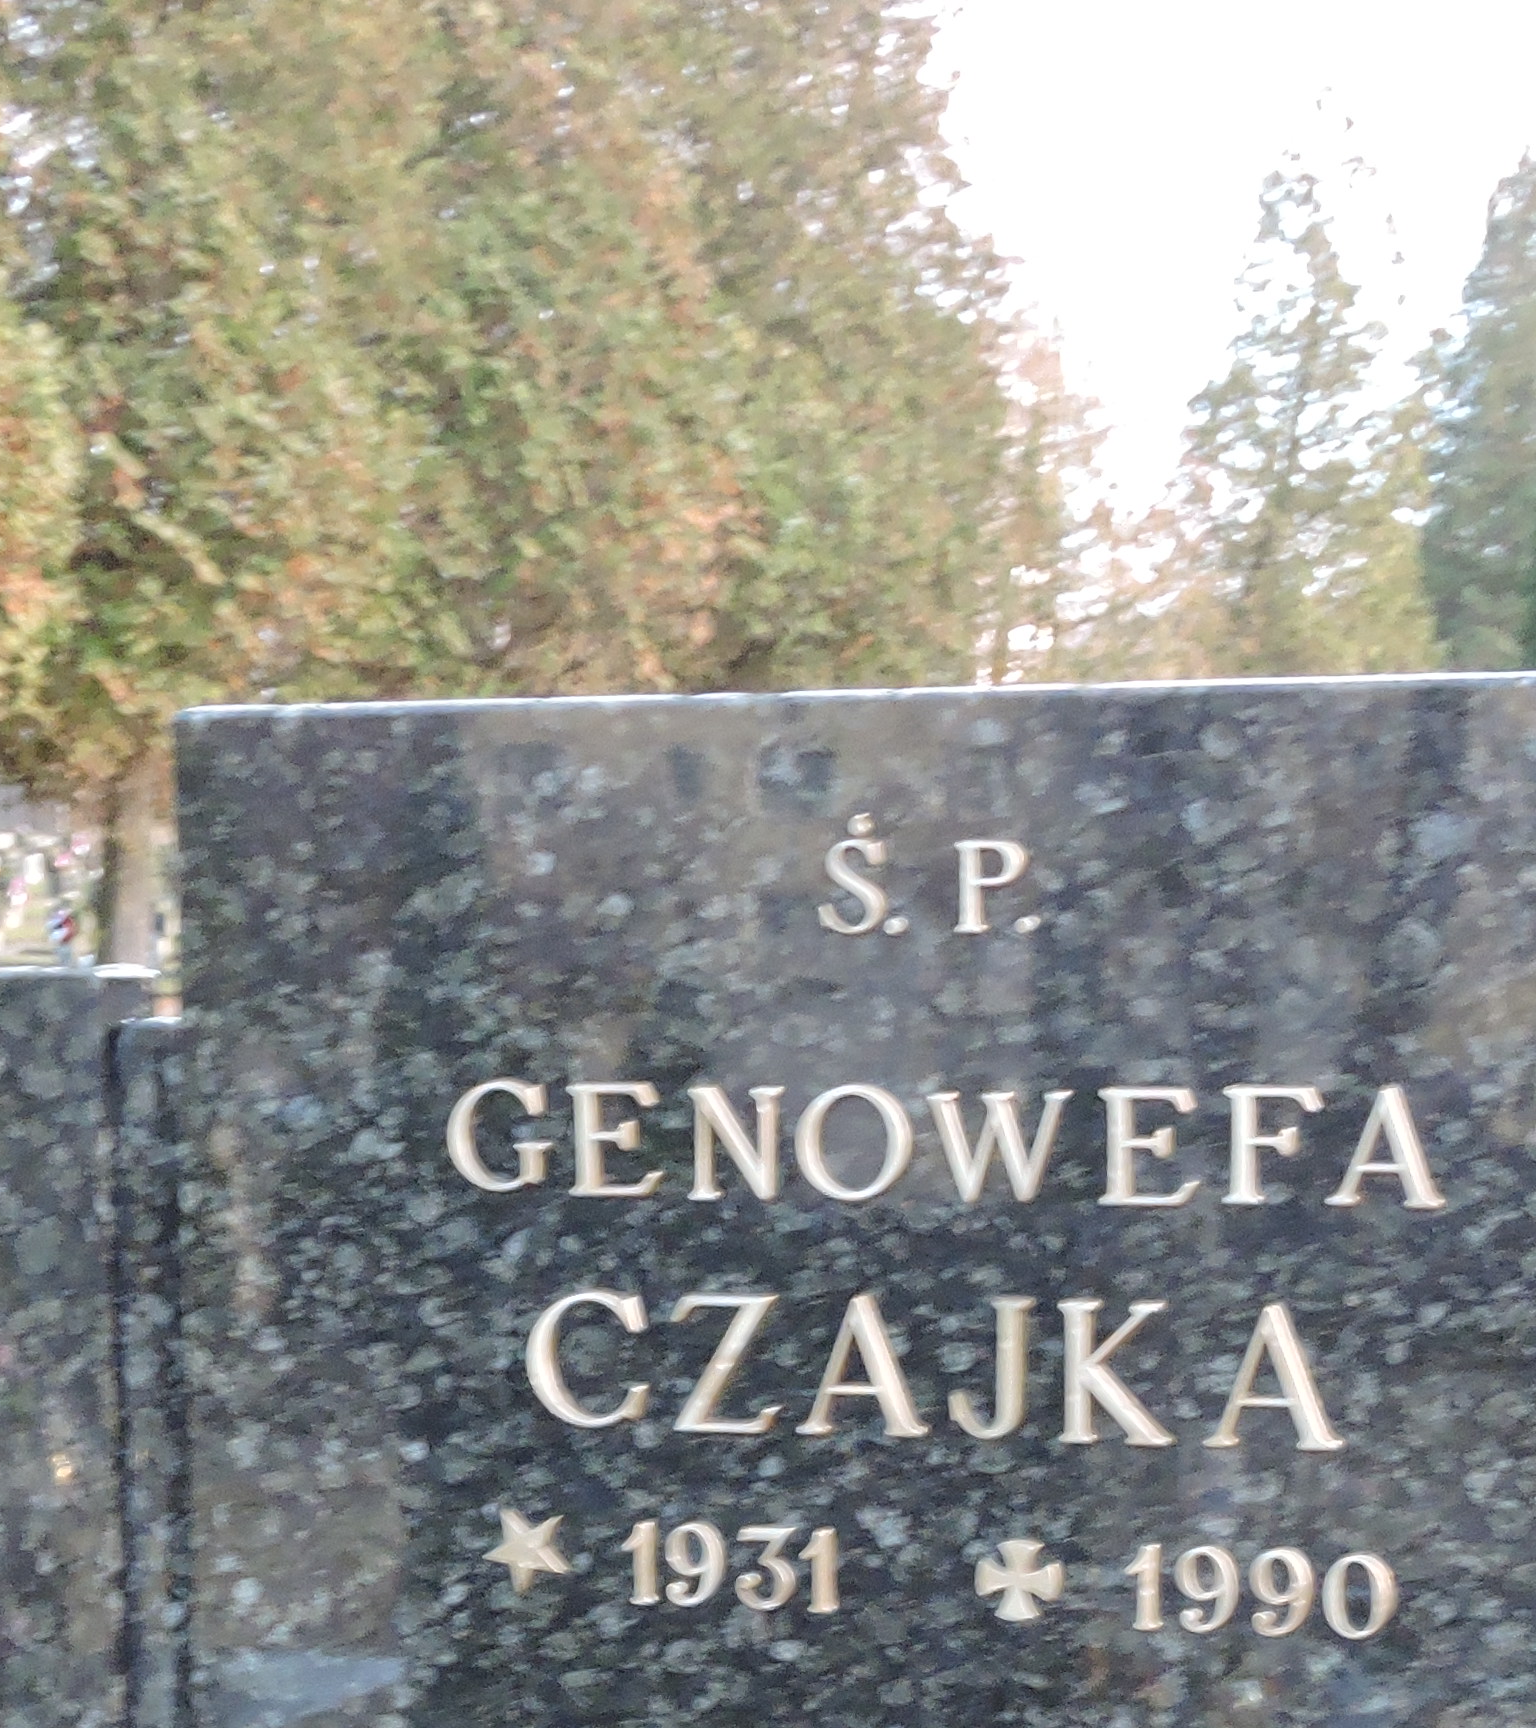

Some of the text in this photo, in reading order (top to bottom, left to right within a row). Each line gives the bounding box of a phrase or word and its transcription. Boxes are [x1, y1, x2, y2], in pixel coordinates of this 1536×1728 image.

[954, 838, 1042, 936] P.
[445, 1077, 1448, 1210] GENOWEFA
[524, 1289, 1346, 1452] CZAJKA
[620, 1518, 1398, 1640] 1931 1990
